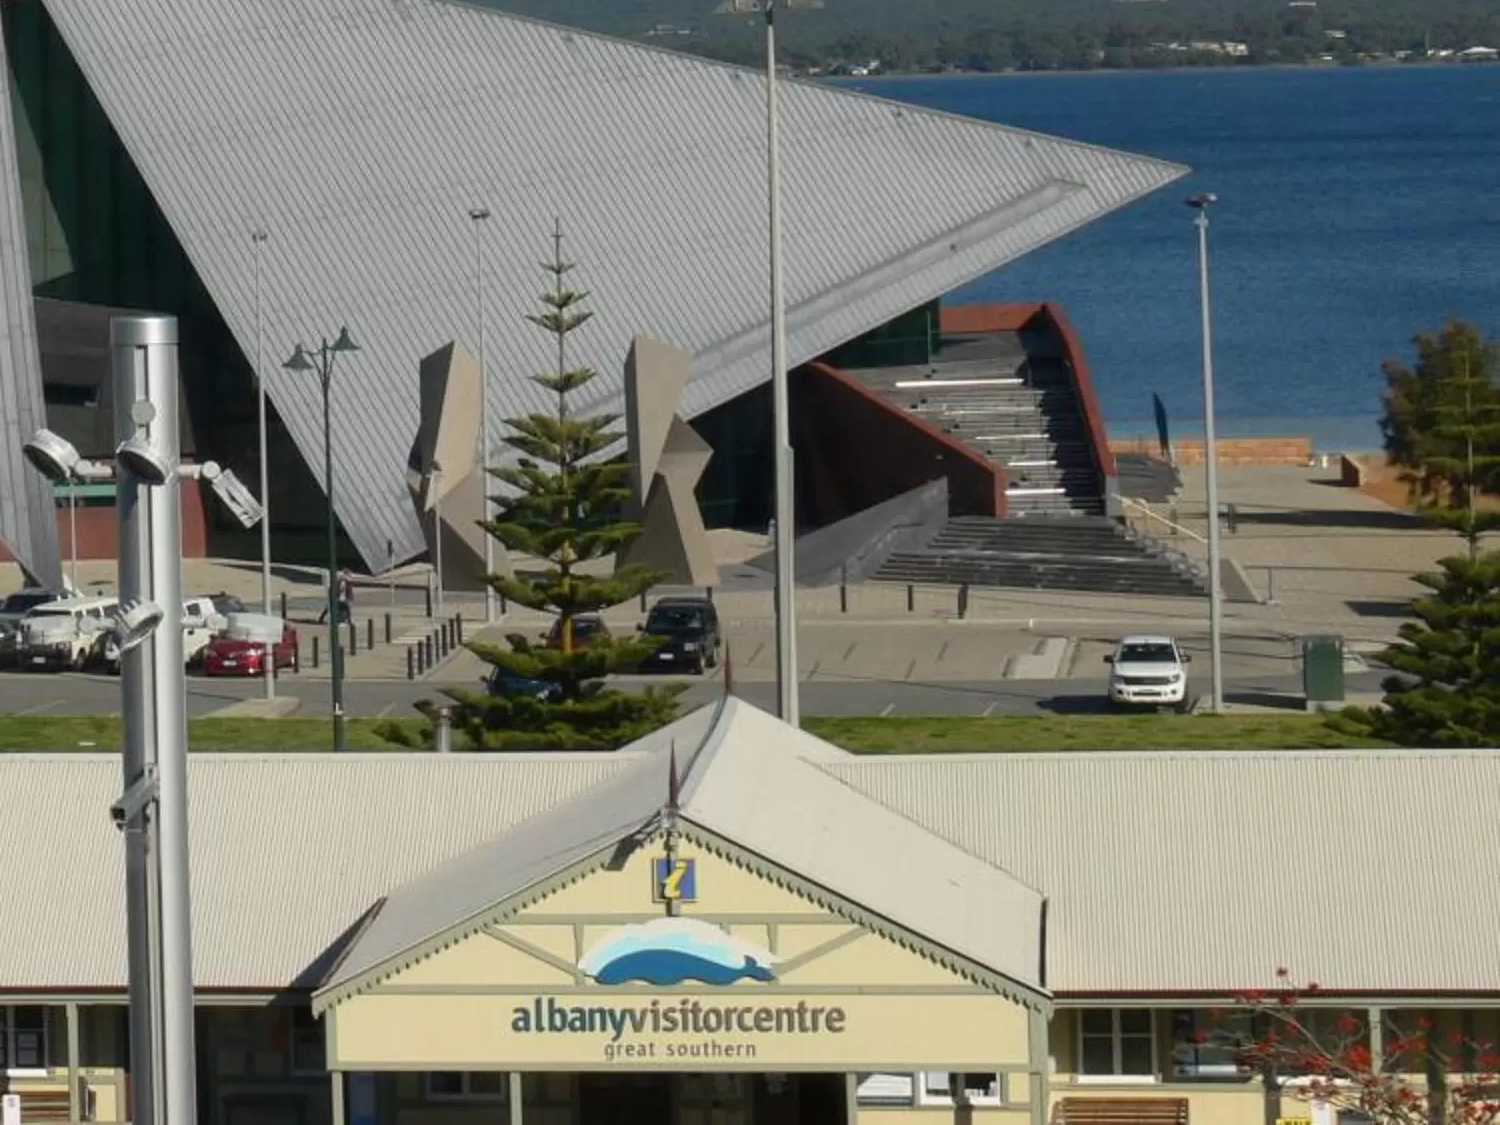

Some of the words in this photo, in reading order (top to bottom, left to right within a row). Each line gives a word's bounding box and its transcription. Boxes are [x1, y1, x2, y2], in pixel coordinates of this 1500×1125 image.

[511, 997, 846, 1042] albanyvisitorcentre
[604, 1042, 655, 1061] great
[666, 1039, 756, 1057] southern
